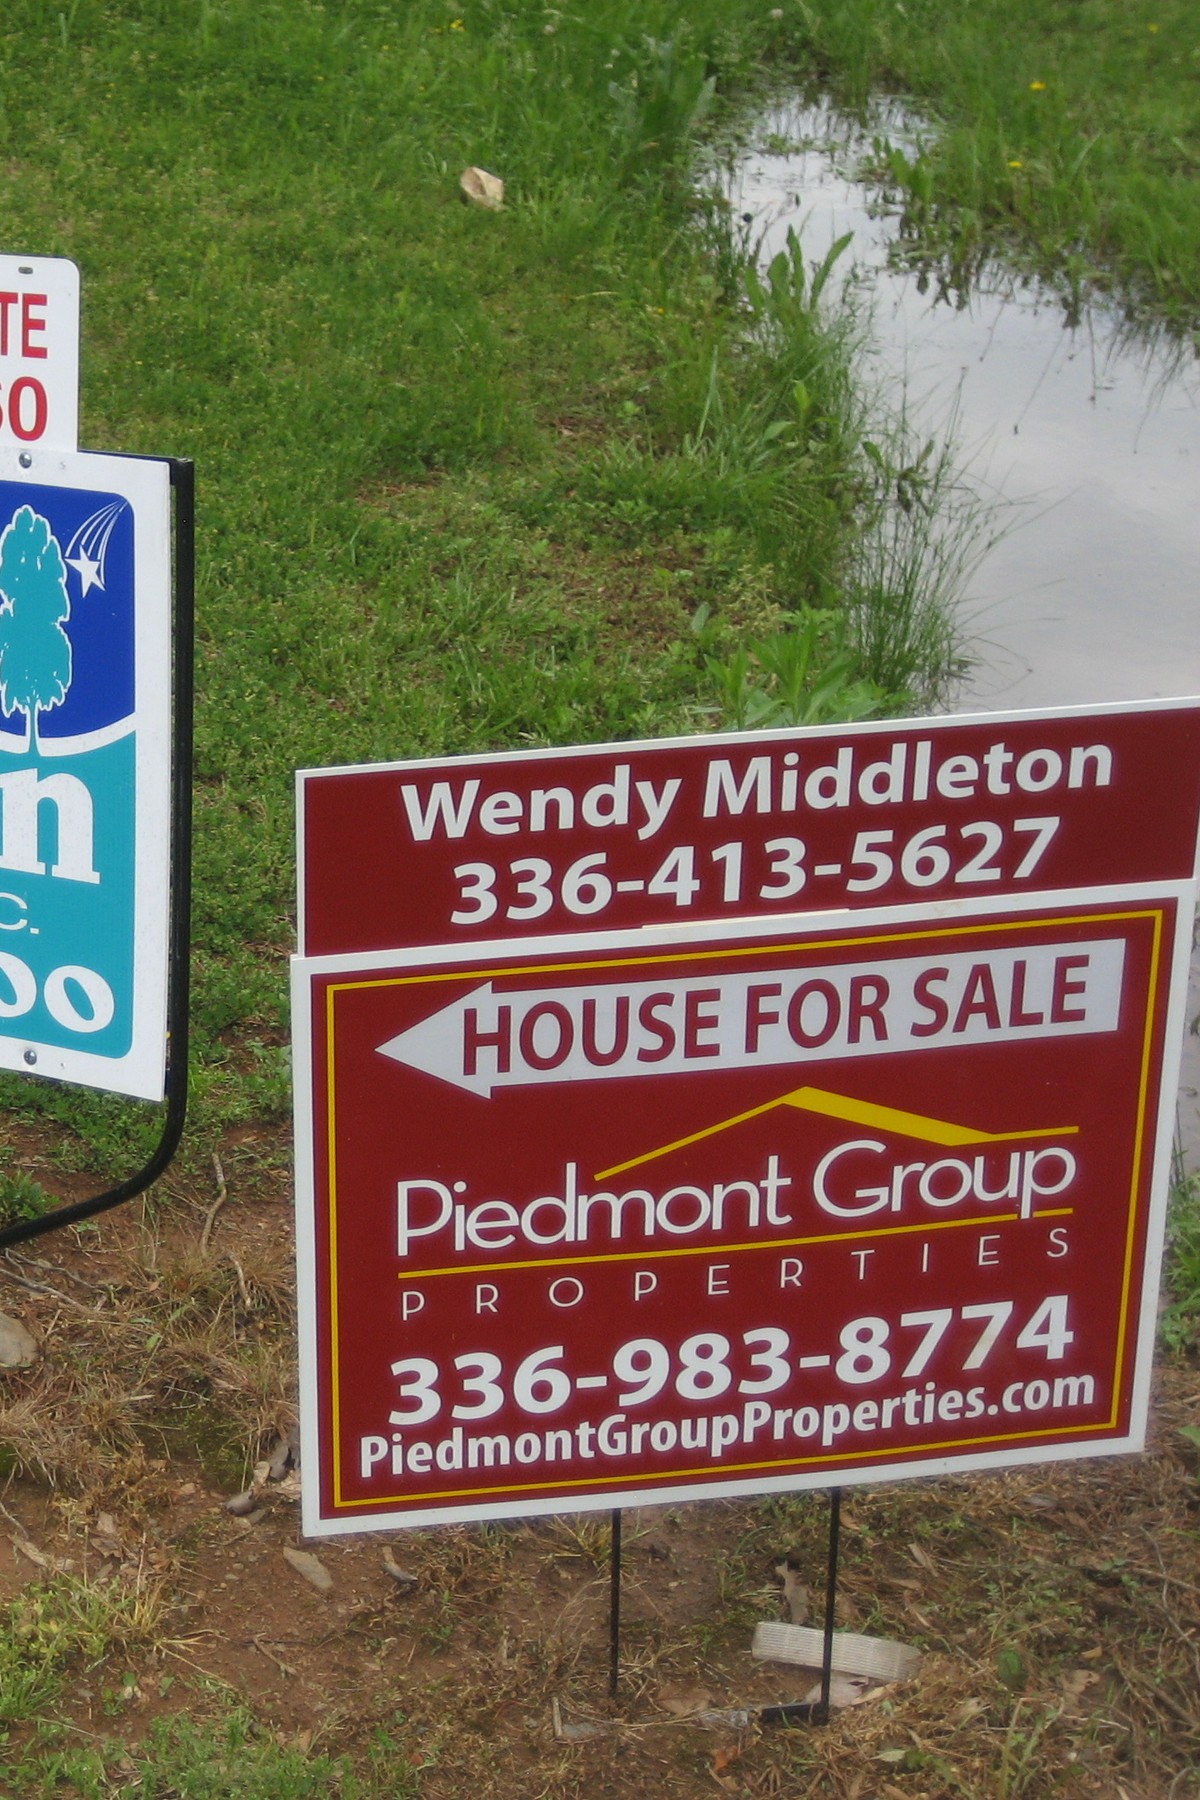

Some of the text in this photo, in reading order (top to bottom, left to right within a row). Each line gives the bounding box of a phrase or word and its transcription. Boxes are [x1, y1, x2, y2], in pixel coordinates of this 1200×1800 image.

[401, 740, 1114, 842] Wendy Middleton
[450, 817, 1061, 925] 336-413-5627
[463, 953, 1089, 1077] HOUSE FOR SALE
[397, 1139, 1077, 1257] Piedmont Group
[401, 1228, 1069, 1321] PROPERTIES
[388, 1294, 1074, 1427] 336-983-8774
[361, 1370, 1095, 1478] PiedmontGroupProperties.com
